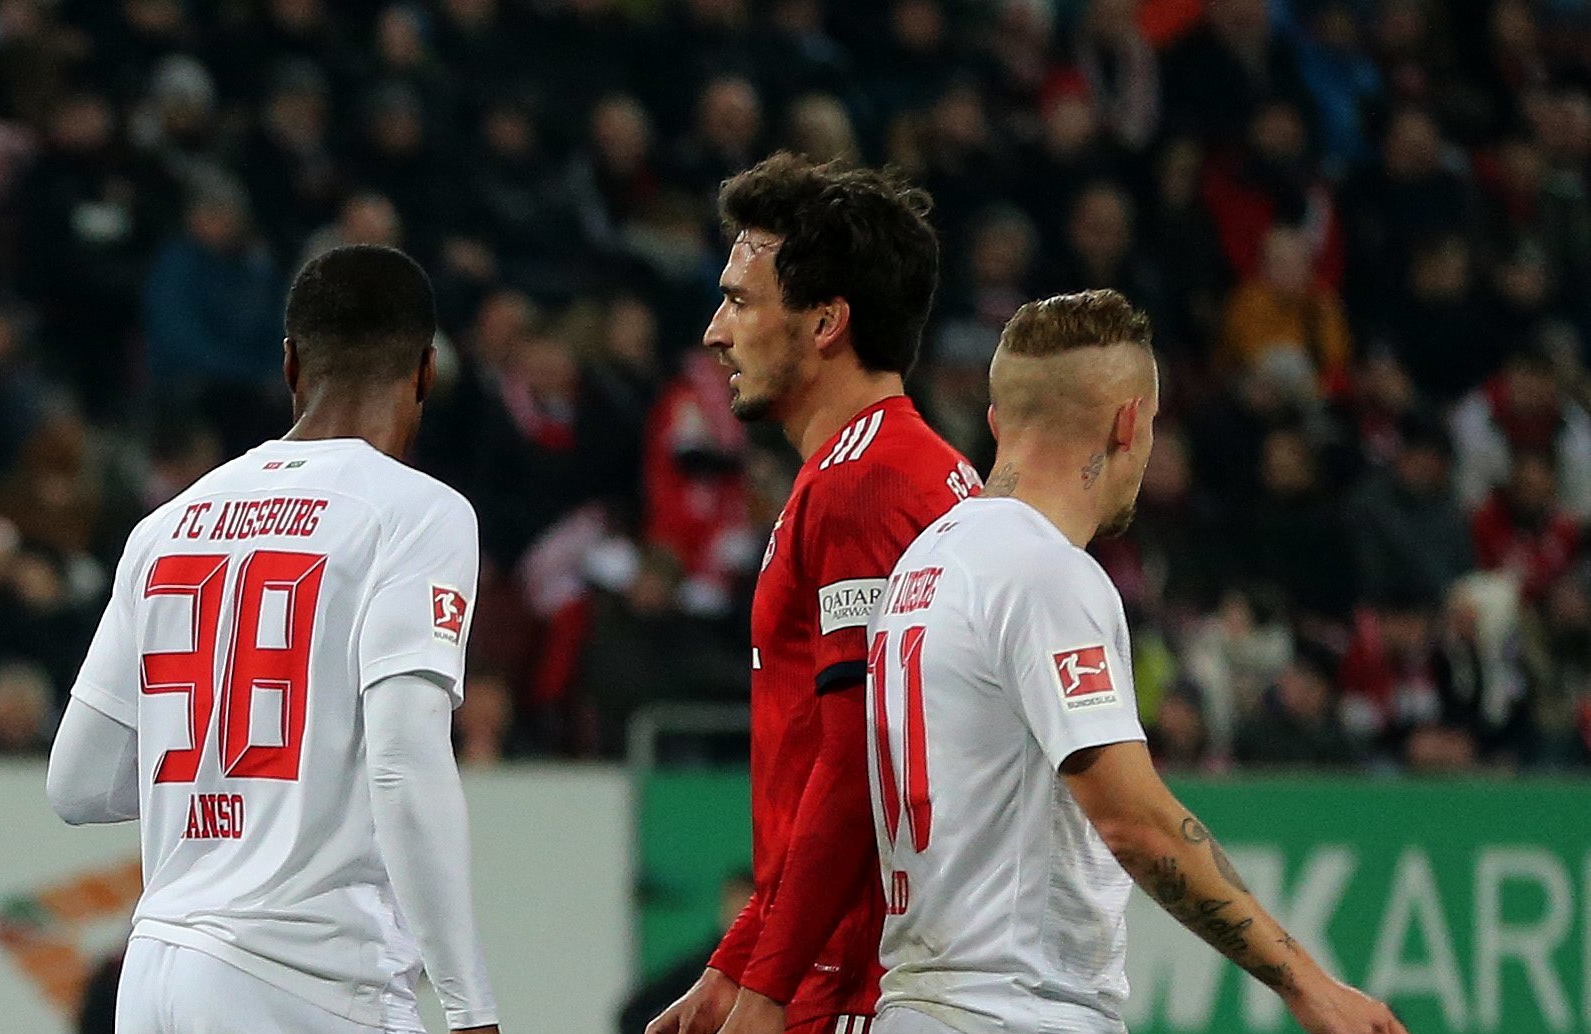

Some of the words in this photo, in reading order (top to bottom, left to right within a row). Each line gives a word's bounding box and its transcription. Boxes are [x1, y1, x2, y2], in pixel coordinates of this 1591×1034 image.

[172, 502, 213, 540] FC
[208, 497, 329, 541] AUGSBURG
[822, 586, 883, 614] QATAR
[140, 549, 331, 784] 38
[180, 793, 244, 840] ANSO
